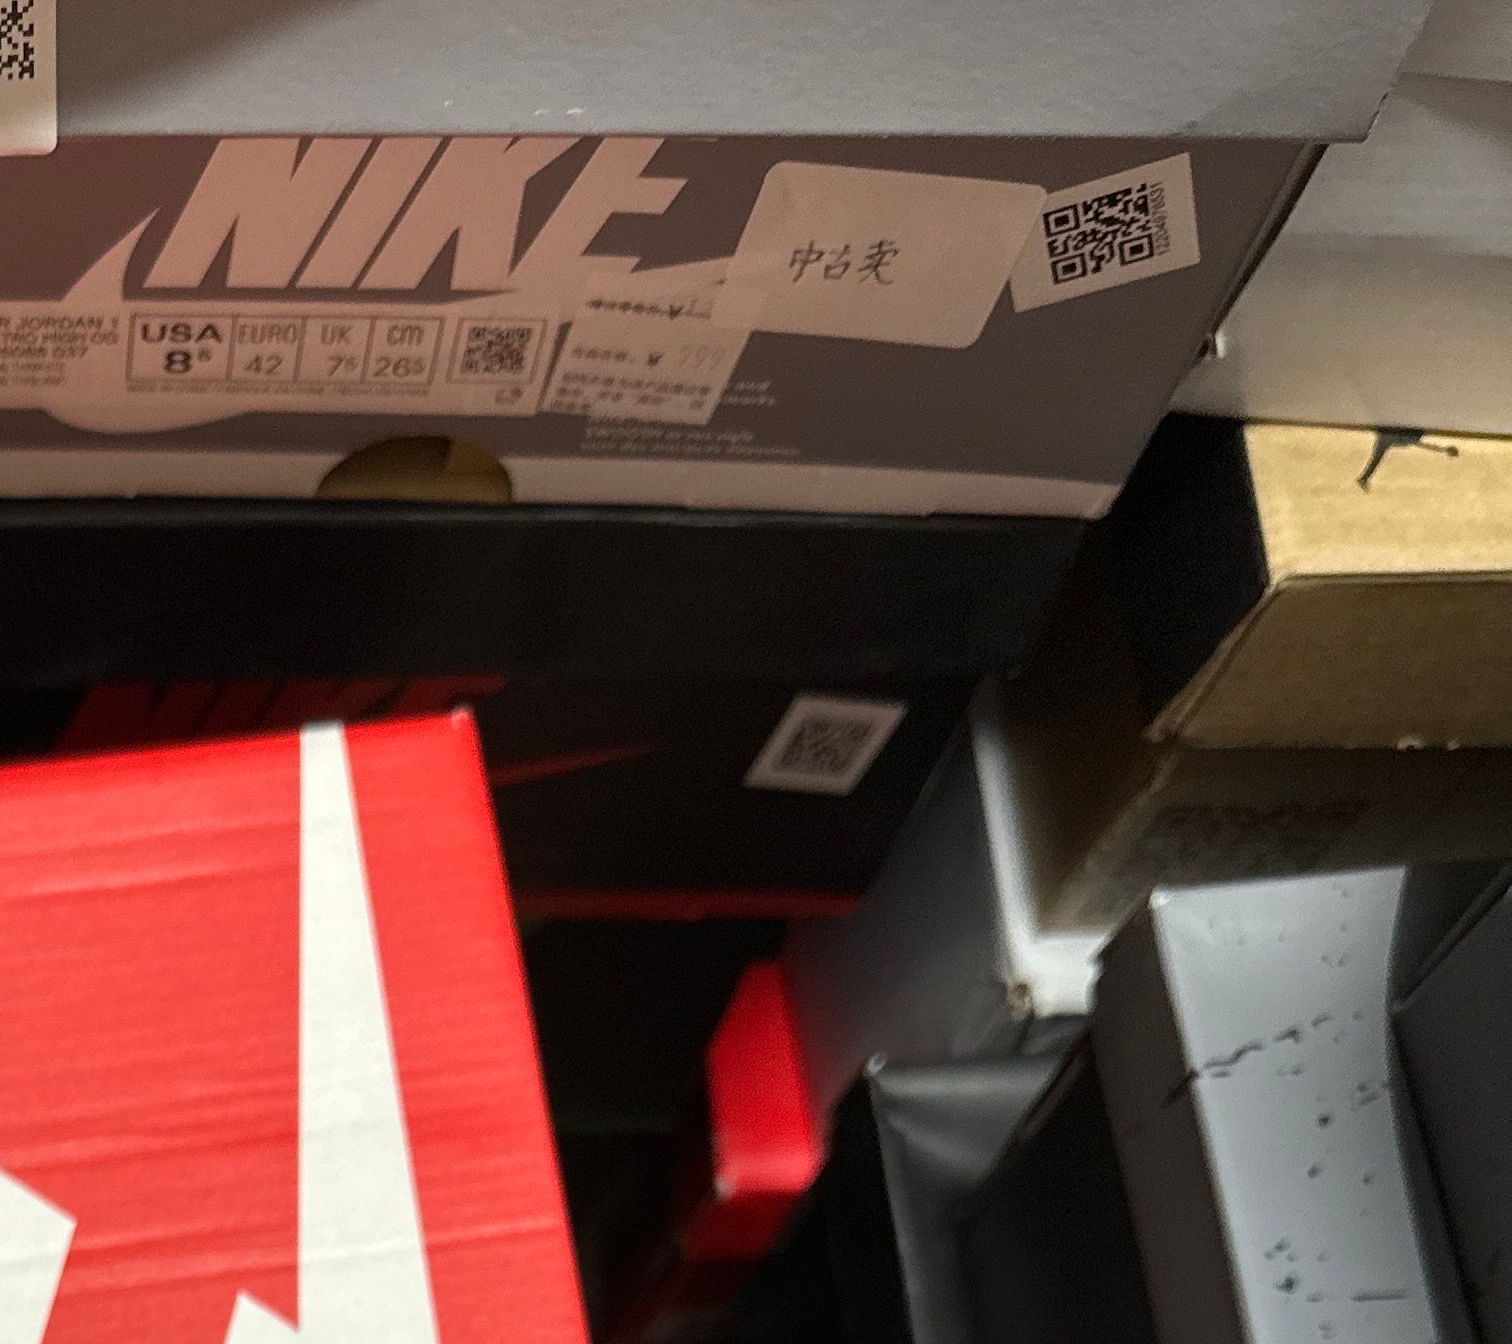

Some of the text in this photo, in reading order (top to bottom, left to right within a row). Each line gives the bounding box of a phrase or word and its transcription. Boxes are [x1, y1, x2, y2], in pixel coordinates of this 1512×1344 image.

[143, 137, 688, 289] NIKE
[16, 315, 104, 330] JORDAN
[141, 322, 222, 344] USA
[237, 323, 299, 345] EURO
[321, 323, 354, 345] UK
[244, 354, 284, 375] 42
